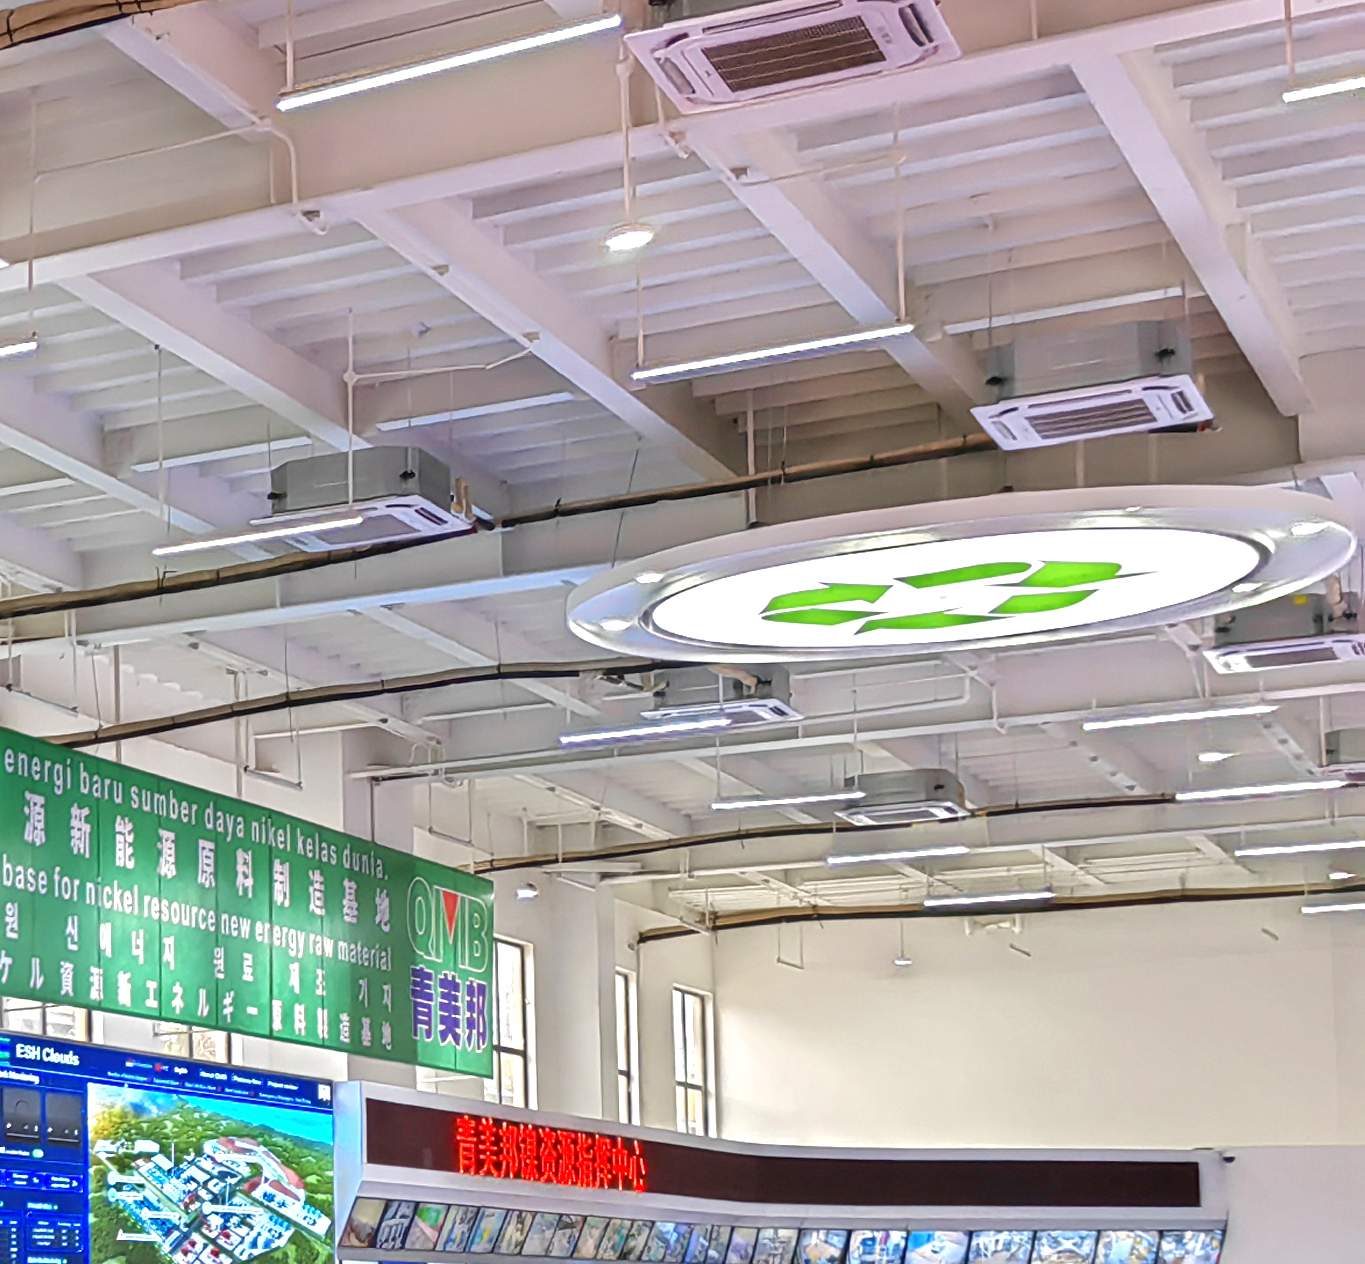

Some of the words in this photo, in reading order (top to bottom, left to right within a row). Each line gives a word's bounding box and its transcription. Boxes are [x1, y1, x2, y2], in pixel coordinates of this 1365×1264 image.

[5, 748, 71, 795] energi
[80, 762, 123, 804] baru
[131, 785, 198, 825] sumber
[204, 804, 245, 842] daya
[251, 818, 291, 852] nikel
[297, 828, 338, 865] kelas
[342, 843, 388, 880] dunia.
[2, 854, 48, 894] base
[53, 867, 80, 900] for
[85, 876, 139, 915] nickel
[143, 893, 216, 931] resource
[221, 912, 251, 939] new
[309, 933, 334, 957] raw
[337, 940, 392, 972] material
[407, 876, 489, 973] QMB
[15, 1044, 41, 1061] ESH
[409, 965, 488, 1053] 青美邦
